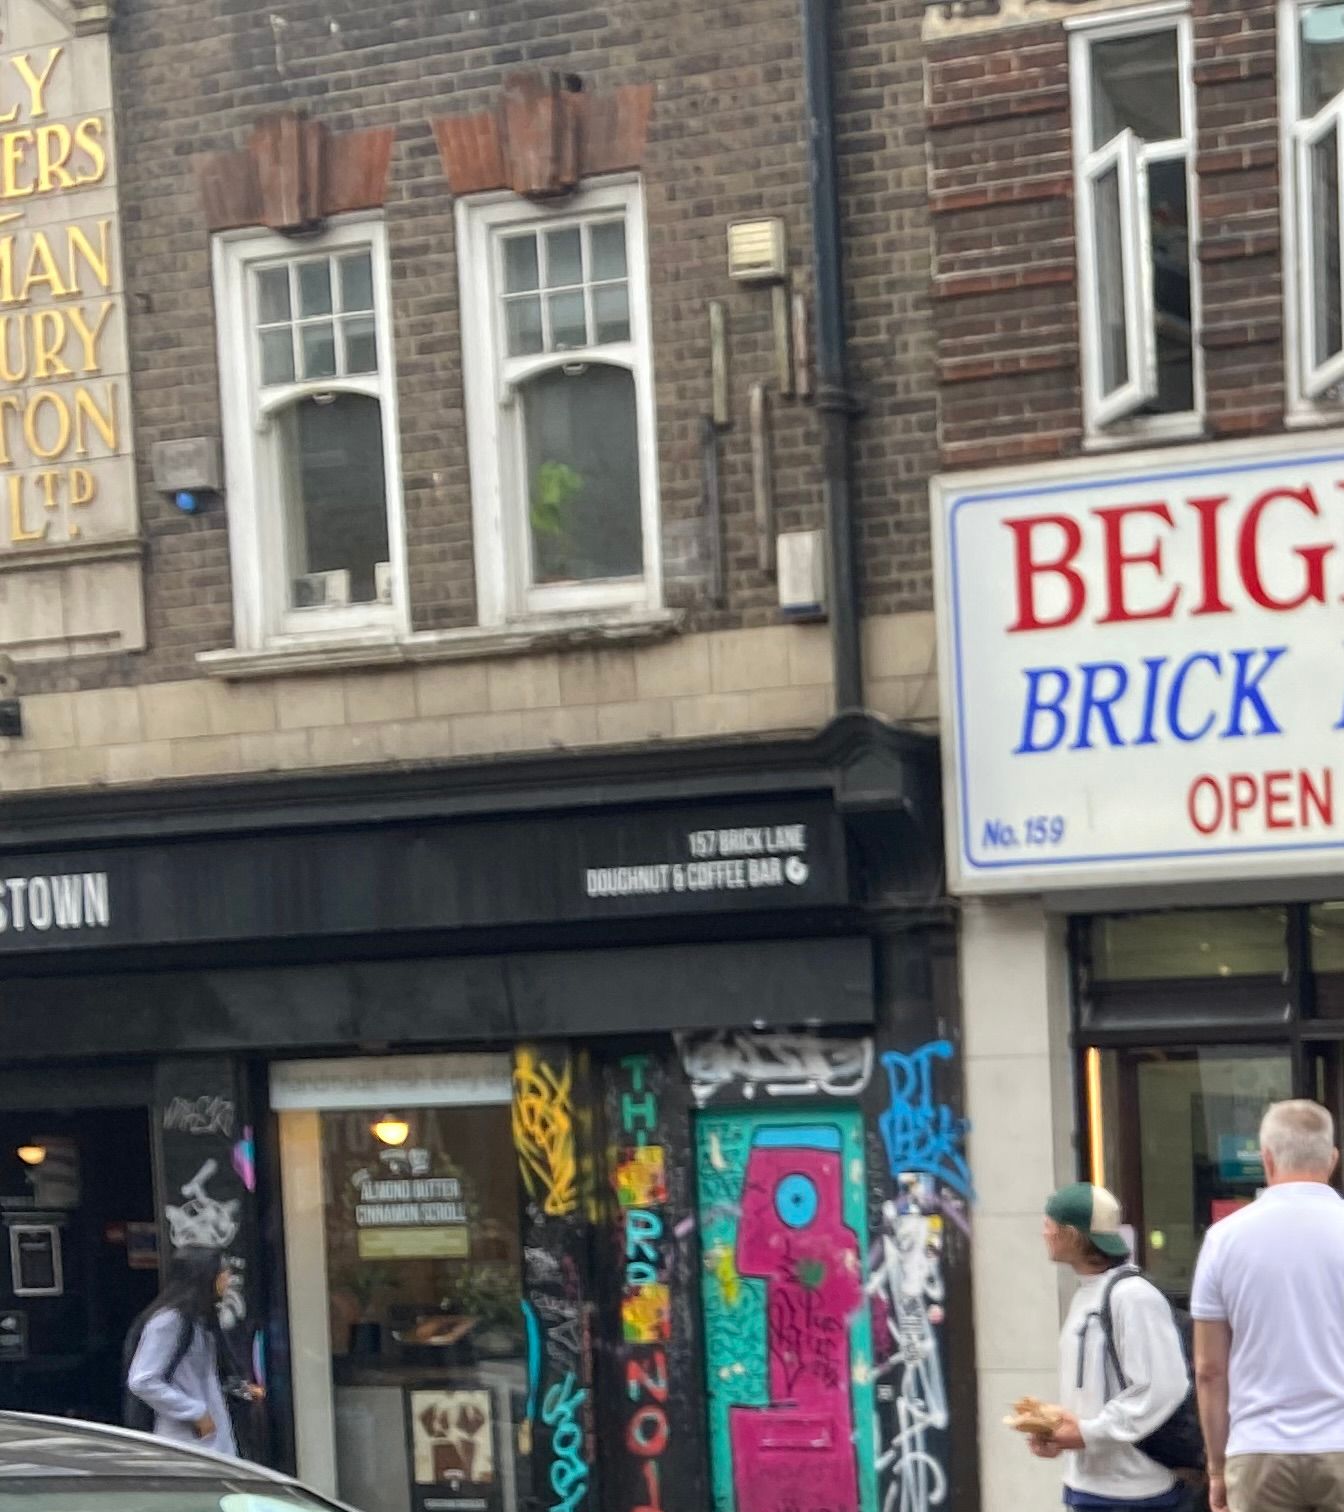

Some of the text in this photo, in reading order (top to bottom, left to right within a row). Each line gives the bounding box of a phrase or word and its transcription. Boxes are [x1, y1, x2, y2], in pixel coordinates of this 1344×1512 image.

[1012, 646, 1288, 756] BRICK
[1187, 767, 1334, 837] OPEN
[718, 826, 765, 856] BRICK
[766, 823, 807, 853] LANE
[586, 863, 671, 898] DOUGHNUT
[687, 858, 746, 892] COFFEE
[748, 856, 785, 888] BAR
[360, 1180, 410, 1202] ALMOND
[355, 1203, 419, 1226] CINNAMON
